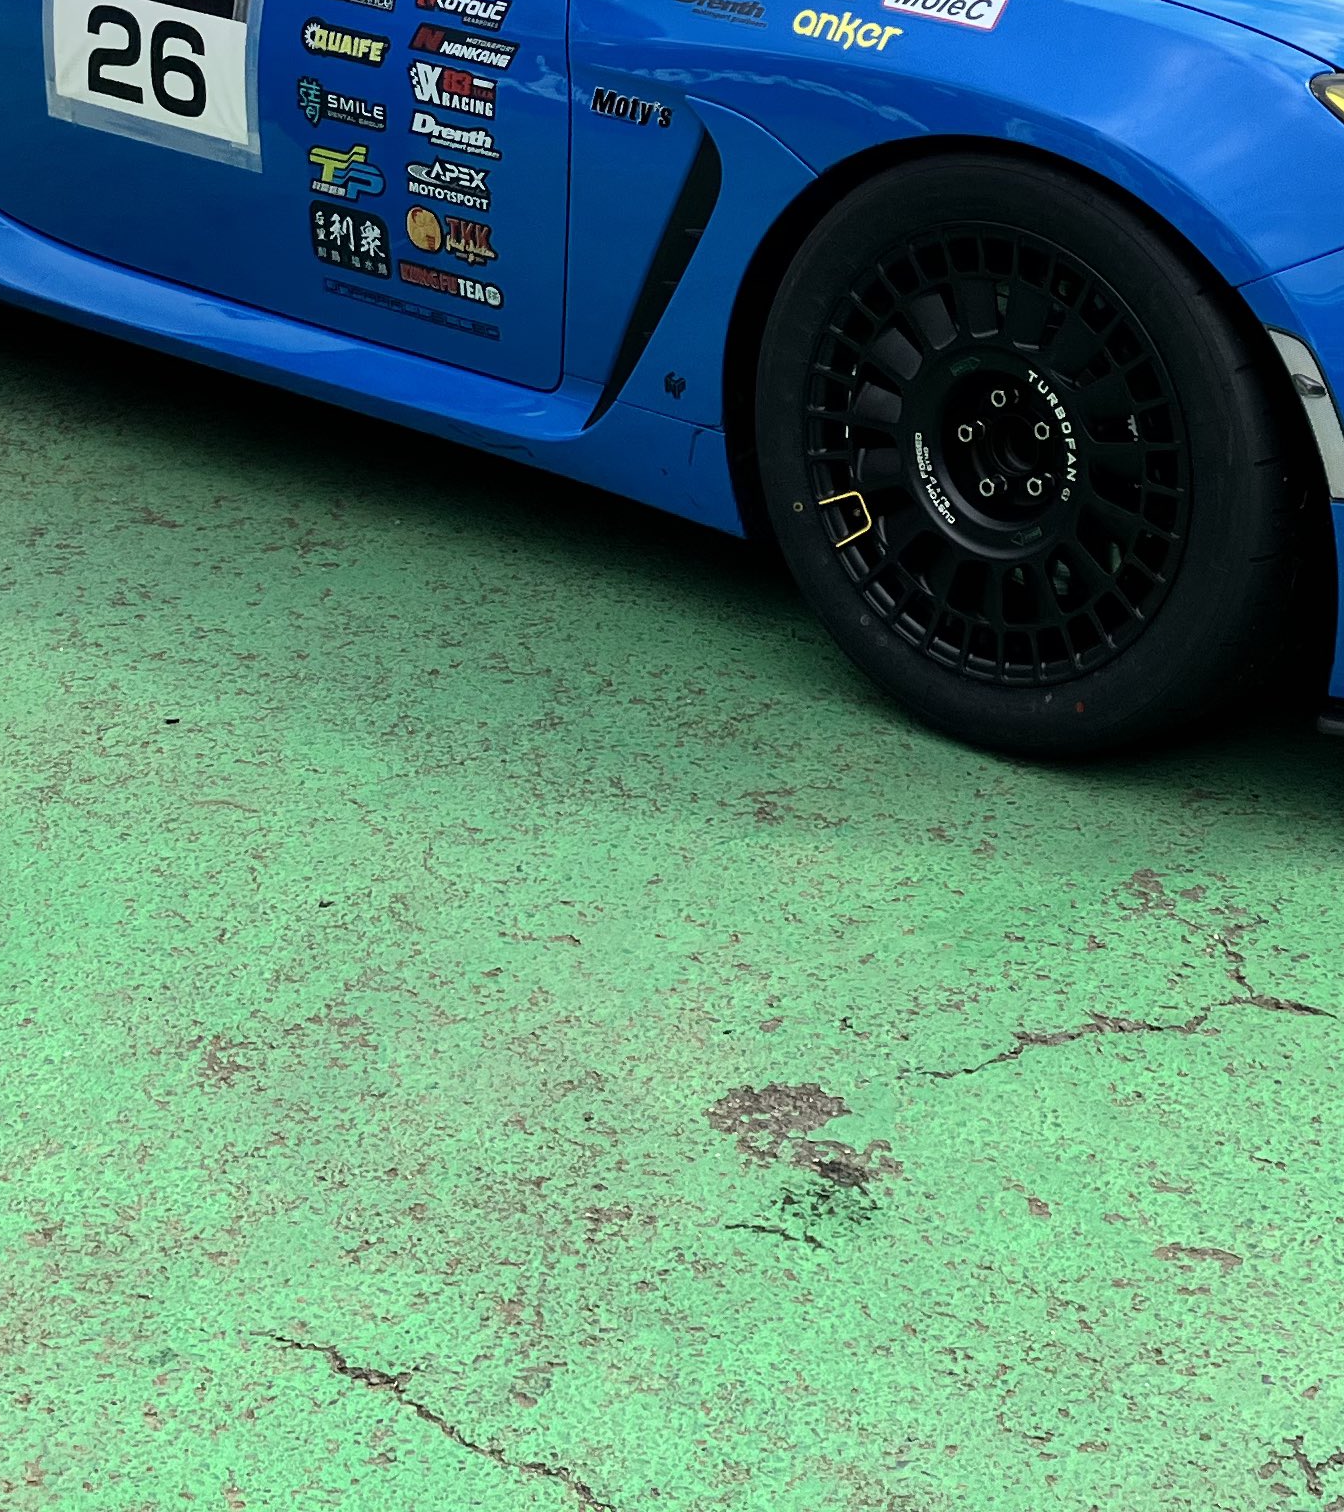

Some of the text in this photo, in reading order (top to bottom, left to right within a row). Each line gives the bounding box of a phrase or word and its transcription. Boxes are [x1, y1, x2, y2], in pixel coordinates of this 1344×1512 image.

[87, 4, 207, 117] 26
[314, 28, 386, 62] QUAIFE
[440, 41, 511, 68] NANKANG
[327, 94, 384, 120] SMILE
[442, 92, 493, 117] RACING
[590, 86, 673, 128] Moty's
[412, 113, 492, 149] Drenth
[431, 161, 486, 190] APEX
[409, 181, 489, 210] MOTORSPORT
[1028, 369, 1077, 482] TURBOFAN
[925, 483, 956, 525] CUSTOM
